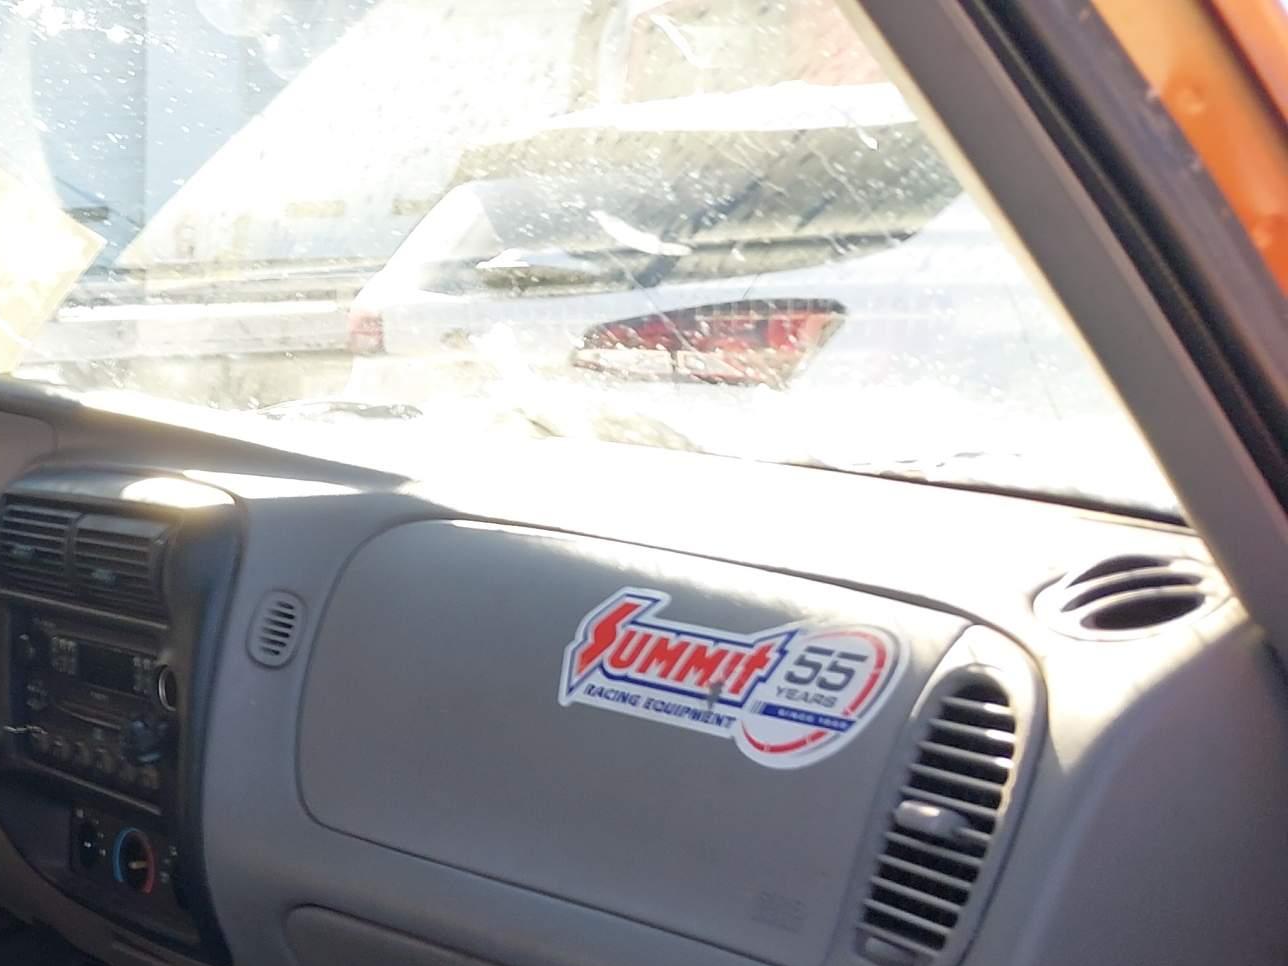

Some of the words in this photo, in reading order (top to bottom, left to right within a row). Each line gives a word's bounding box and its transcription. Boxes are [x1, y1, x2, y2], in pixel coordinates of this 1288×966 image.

[576, 602, 774, 694] SUMMIT
[785, 646, 868, 692] 55
[584, 683, 640, 707] RACING
[643, 697, 736, 729] EQUIPMENT
[776, 686, 837, 708] YEARS
